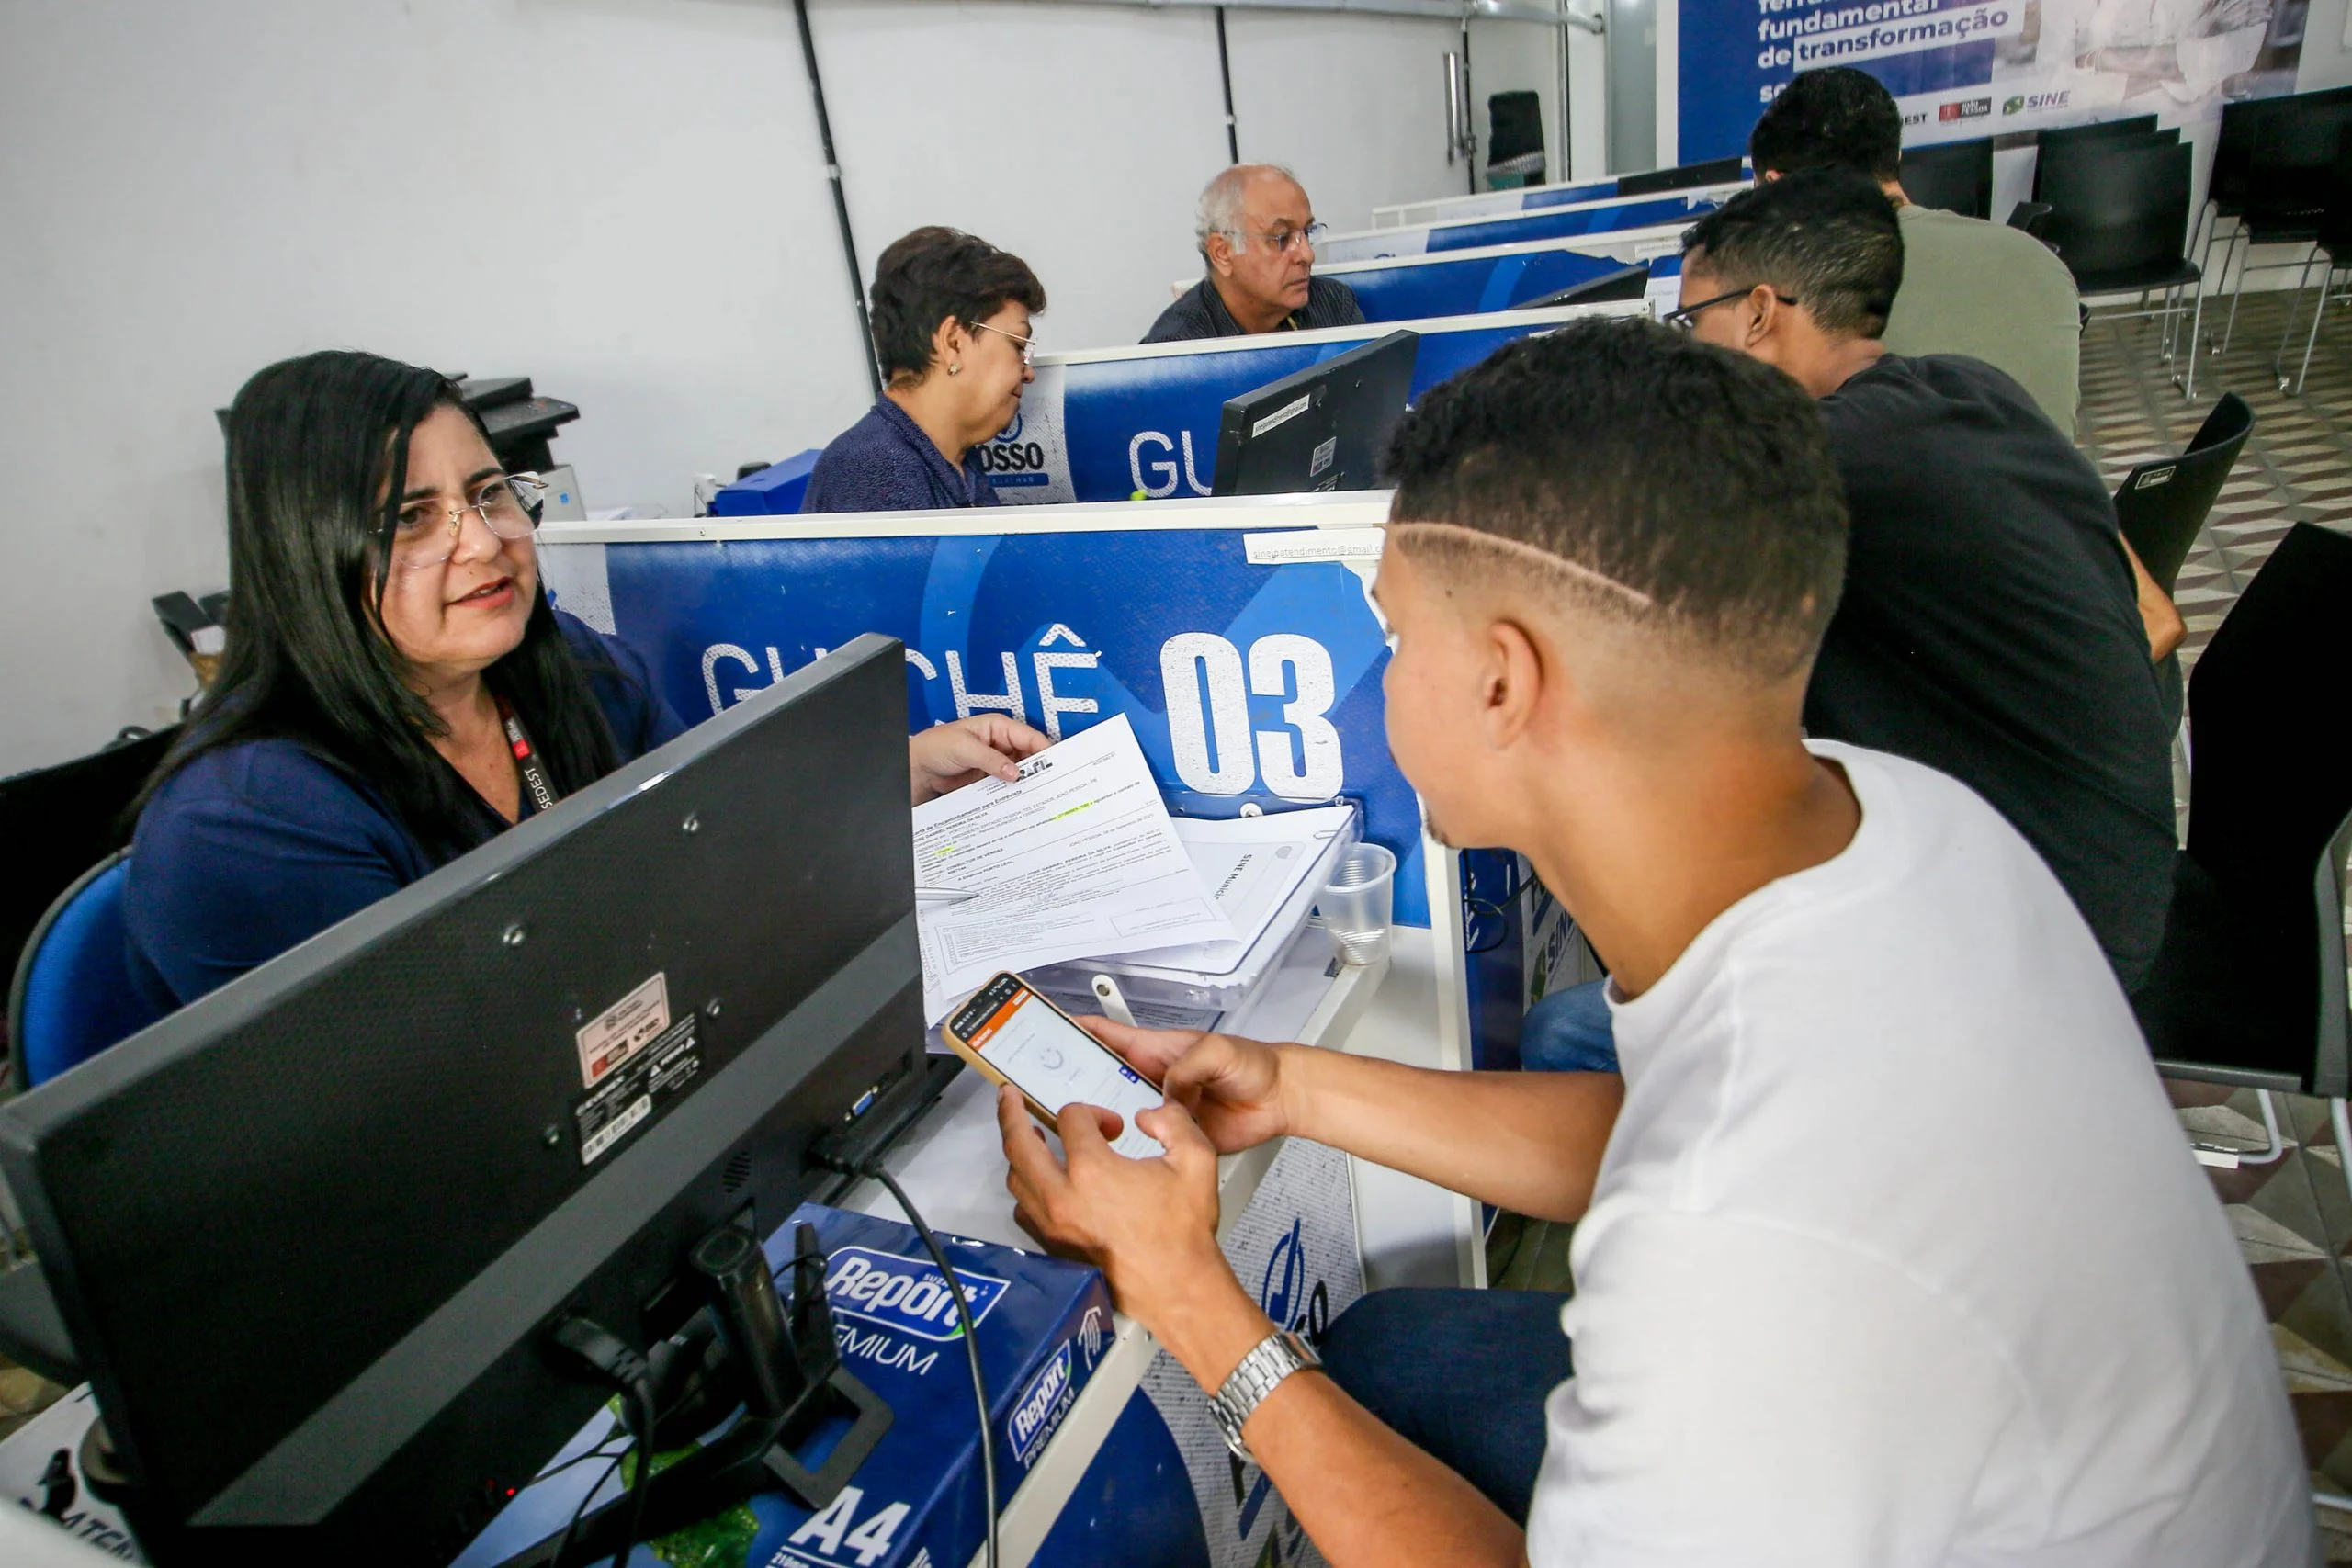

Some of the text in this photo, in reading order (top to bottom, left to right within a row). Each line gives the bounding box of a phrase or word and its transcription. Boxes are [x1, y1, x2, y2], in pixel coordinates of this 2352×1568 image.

[1758, 0, 1939, 42] fundamental
[1758, 8, 2009, 69] de transformação
[1903, 113, 1928, 126] EST
[2027, 90, 2071, 108] SINE
[977, 442, 1044, 472] OSSO
[1253, 544, 1383, 560] sinejpatendimento@gmail.c
[1159, 631, 1344, 803] 03
[524, 767, 553, 809] SEDEST
[1233, 853, 1253, 872] SINE
[824, 1256, 978, 1328] Report
[834, 1323, 939, 1376] EMIUM
[1014, 1356, 1067, 1443] Report
[787, 1484, 912, 1568] A4
